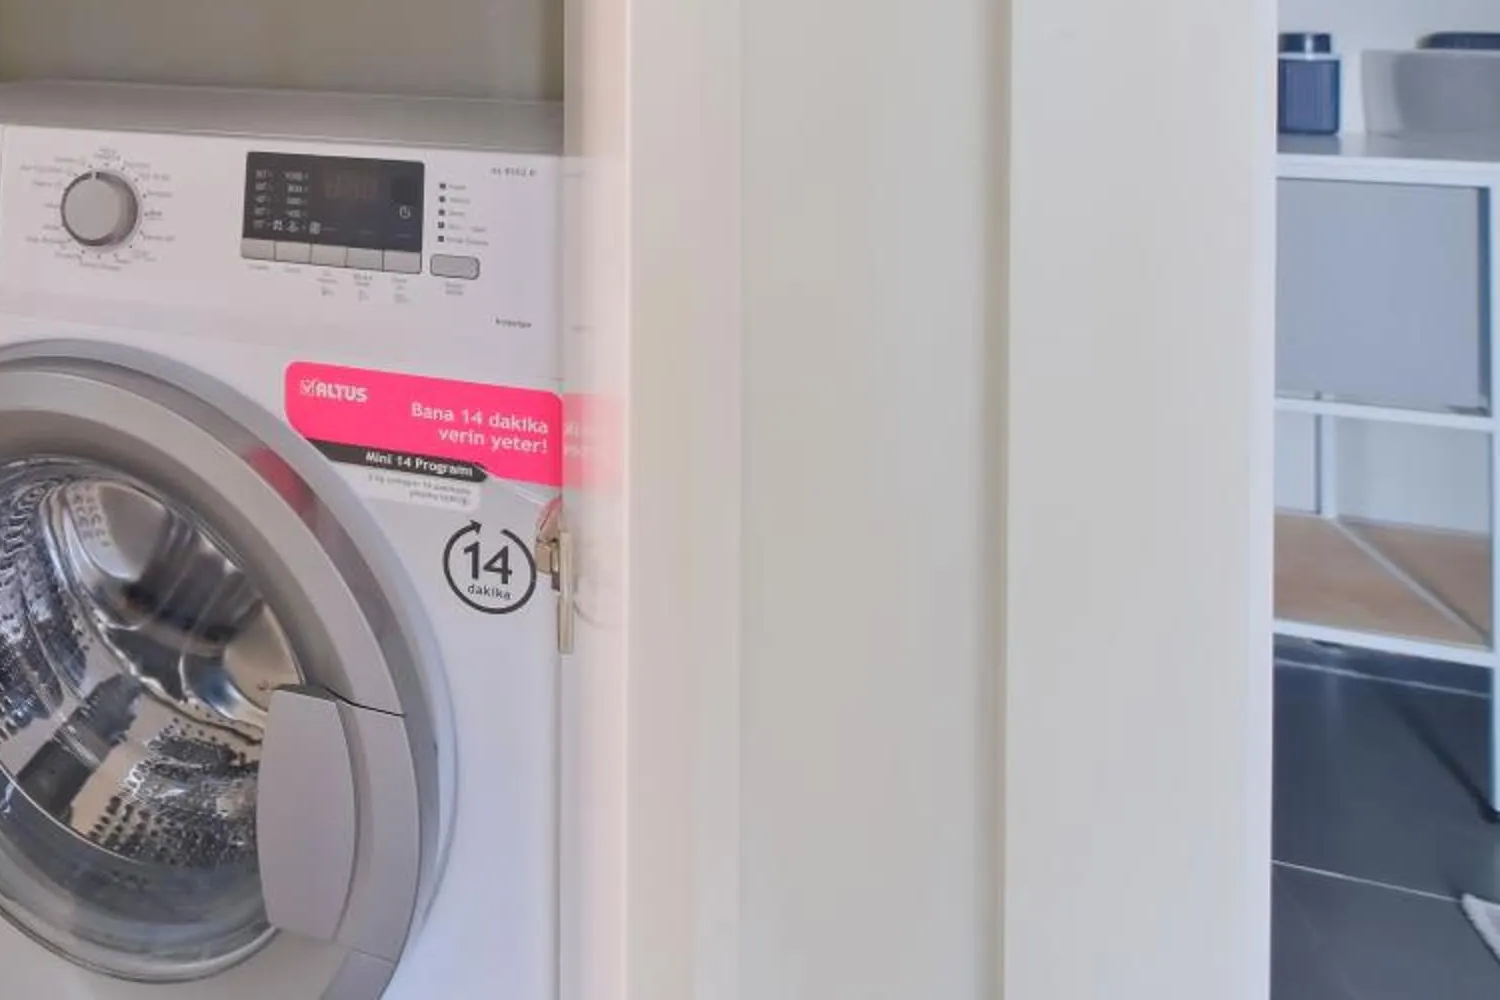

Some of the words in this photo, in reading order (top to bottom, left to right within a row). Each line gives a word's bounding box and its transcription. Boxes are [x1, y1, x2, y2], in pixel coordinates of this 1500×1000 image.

[315, 381, 368, 403] ALTUS
[411, 402, 454, 421] Bana
[461, 408, 483, 425] 14
[489, 411, 548, 434] dakika
[438, 427, 485, 445] verin
[490, 434, 548, 454] yeter!
[365, 451, 392, 465] Mini
[397, 455, 411, 468] 14
[463, 540, 513, 585] 14
[467, 584, 512, 600] dakika
